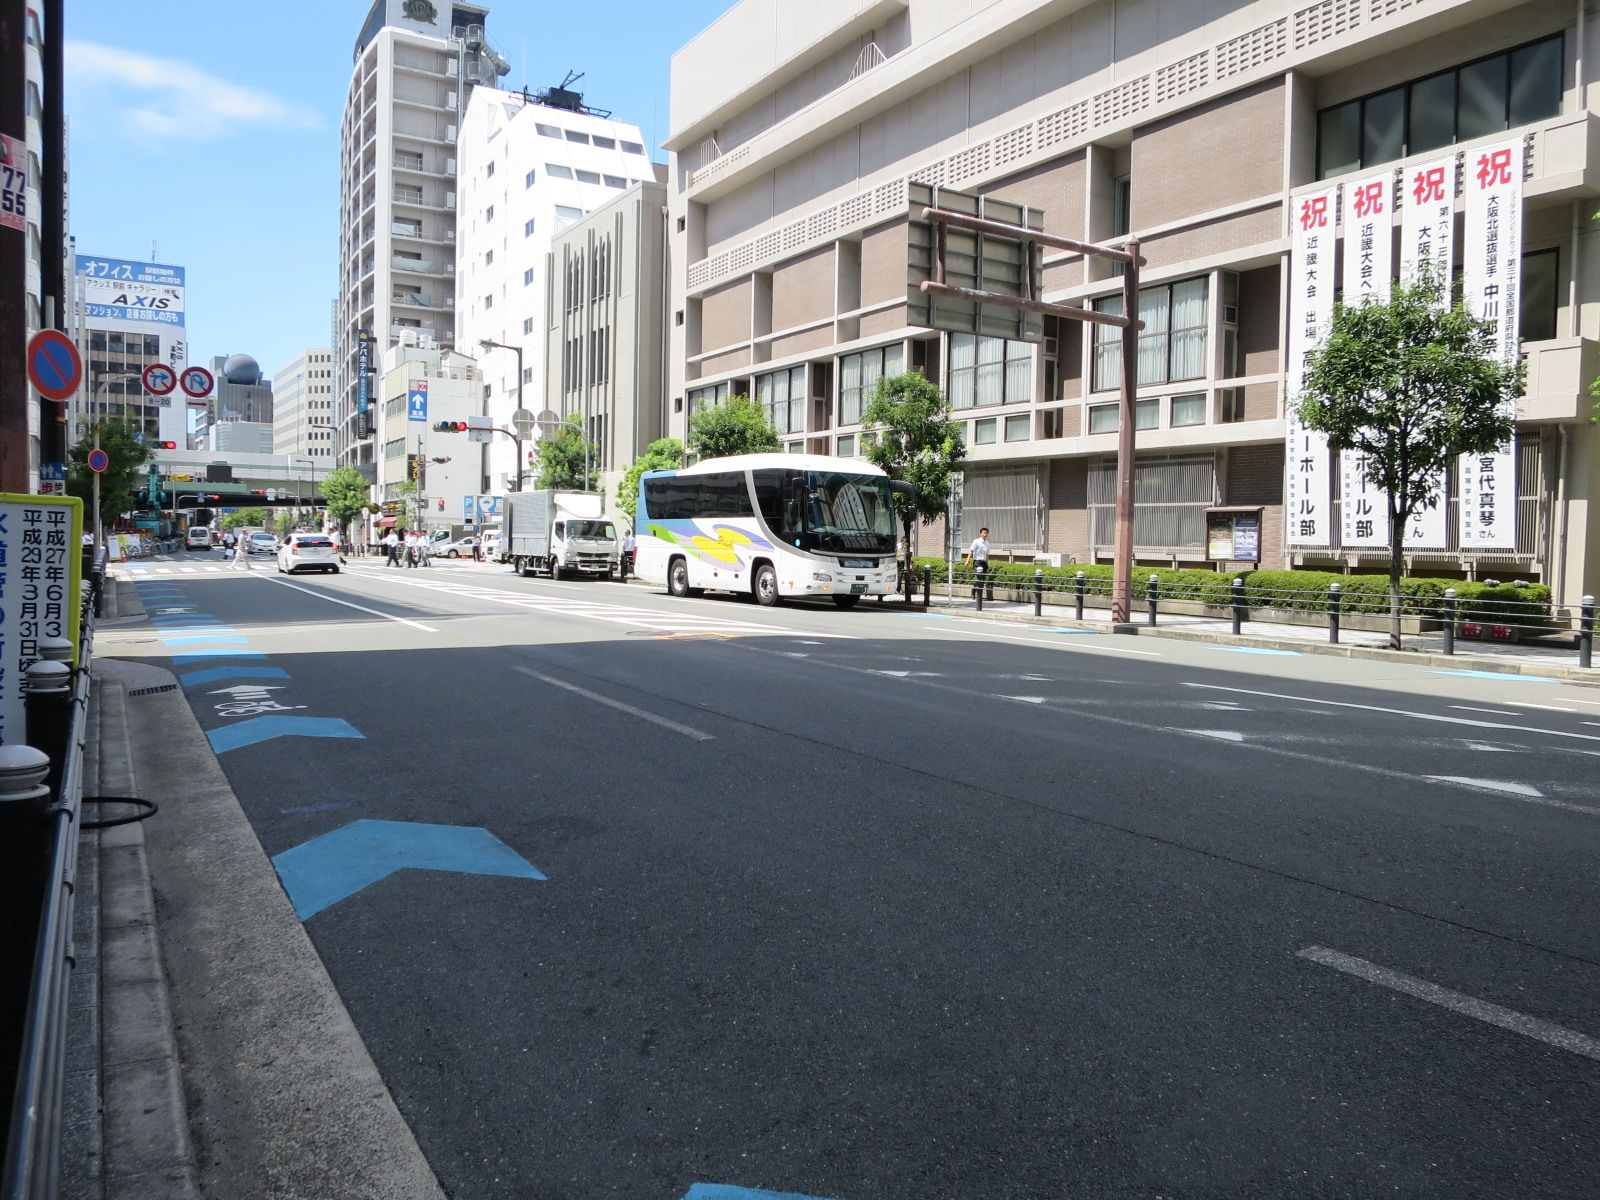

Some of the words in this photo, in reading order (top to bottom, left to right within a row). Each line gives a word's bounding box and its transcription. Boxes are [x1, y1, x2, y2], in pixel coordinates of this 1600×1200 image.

[1413, 166, 1445, 206] 祝
[1476, 148, 1512, 190] 祝
[1300, 196, 1328, 231] 祝
[1353, 181, 1383, 219] 祝
[1486, 194, 1499, 278] 大阪北選抜選手
[85, 260, 134, 280] オフィス
[112, 293, 171, 309] AXIS
[360, 341, 368, 377] アパホテル
[1479, 456, 1495, 527] 宮代真琴
